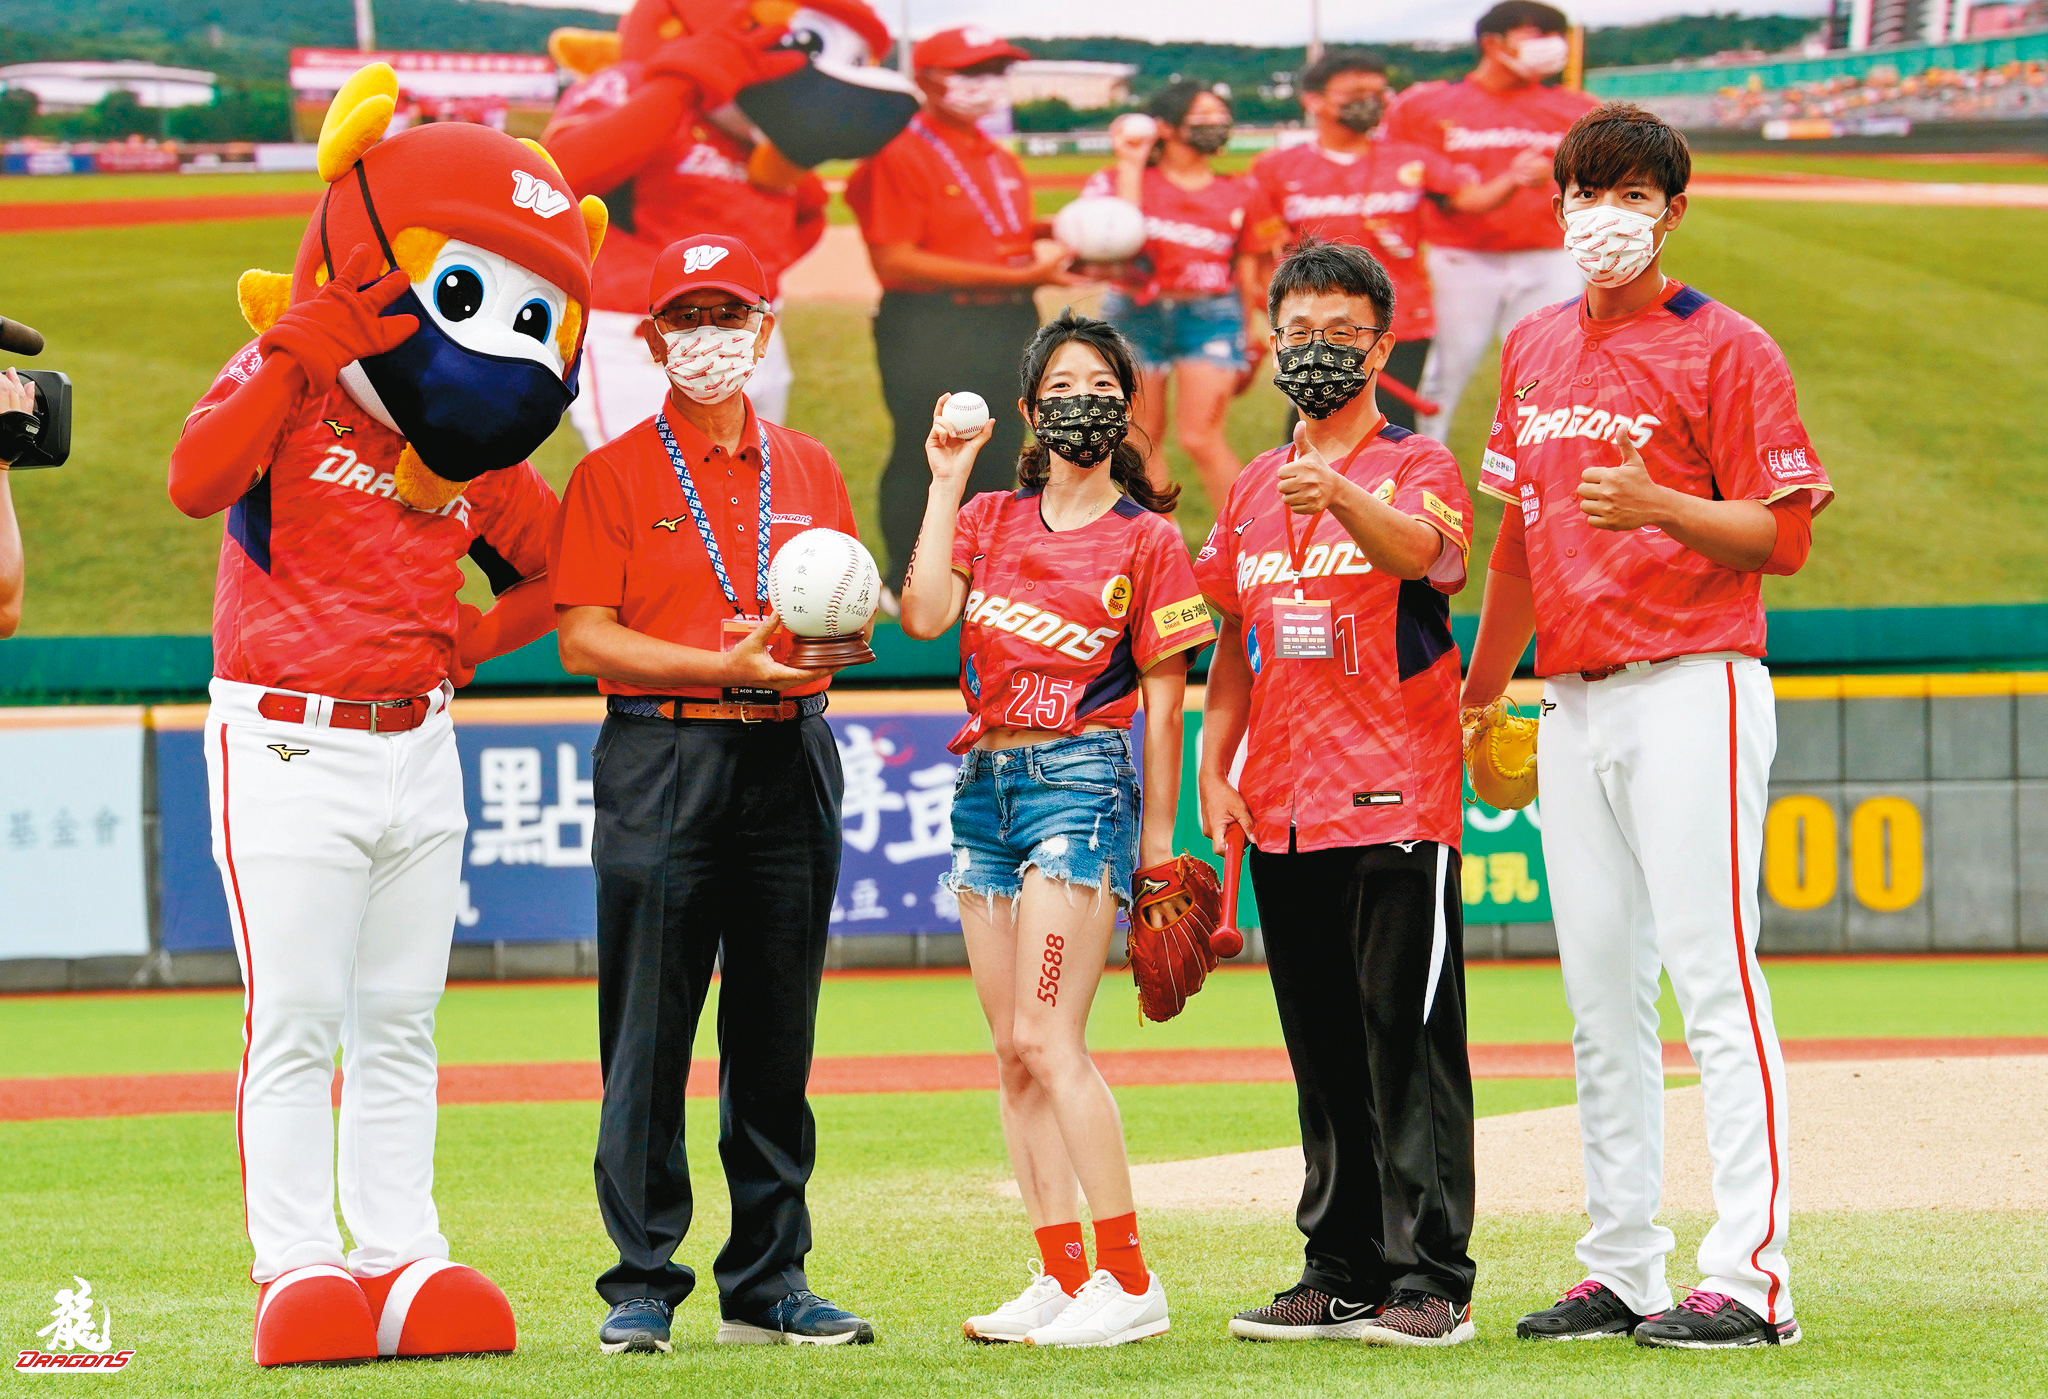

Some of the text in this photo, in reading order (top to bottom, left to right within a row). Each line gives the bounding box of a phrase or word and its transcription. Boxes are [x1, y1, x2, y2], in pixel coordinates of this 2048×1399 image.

[512, 169, 571, 219] W
[683, 244, 729, 274] W
[1516, 404, 1662, 449] DRAGONS
[308, 444, 472, 530] DRAN
[1768, 447, 1811, 472] 貝納頌
[963, 590, 1120, 661] RAGONS
[1181, 602, 1208, 622] 台灣
[1334, 613, 1359, 675] 1
[1005, 670, 1073, 729] 25
[469, 742, 596, 867] 點
[1764, 794, 1923, 912] 00
[1036, 933, 1065, 1008] 55688
